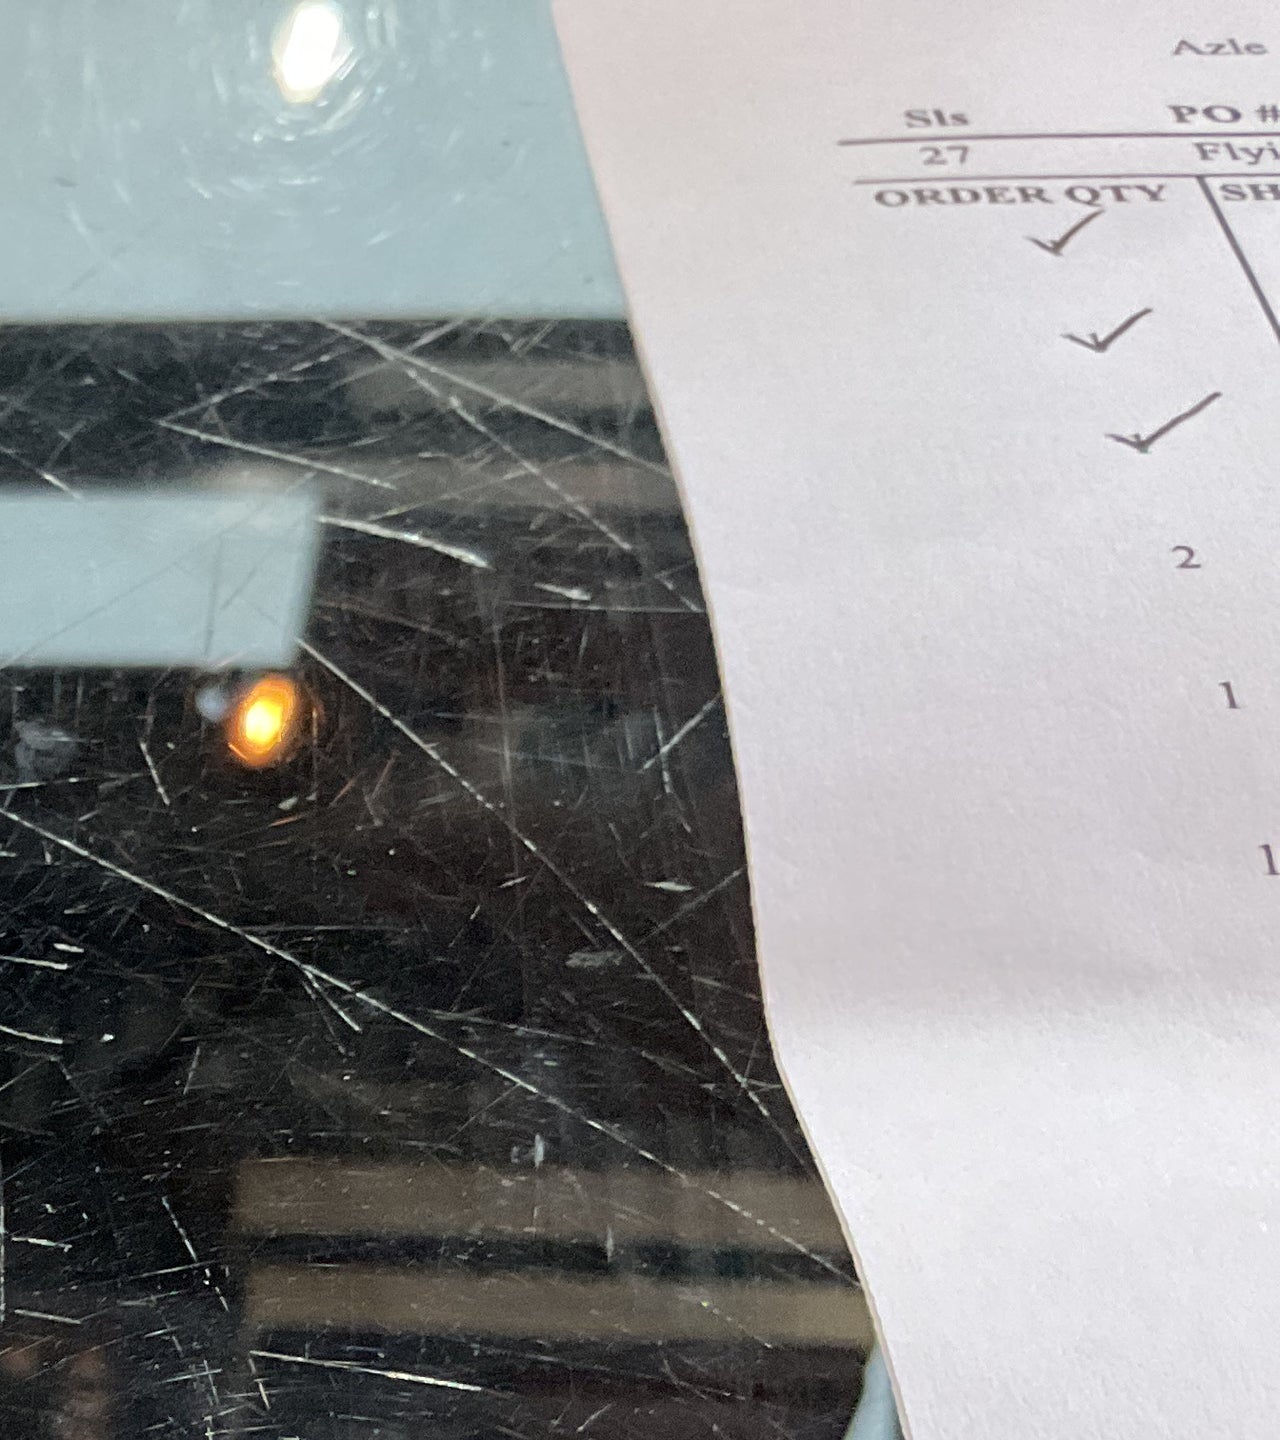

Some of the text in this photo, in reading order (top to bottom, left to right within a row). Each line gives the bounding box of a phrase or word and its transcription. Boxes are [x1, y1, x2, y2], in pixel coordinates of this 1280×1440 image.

[1172, 38, 1269, 56] Azle
[1167, 104, 1243, 123] PO
[919, 145, 971, 165] 27
[874, 182, 1167, 208] ORDER QTY
[1171, 544, 1203, 570] 2
[1219, 681, 1241, 709] 1
